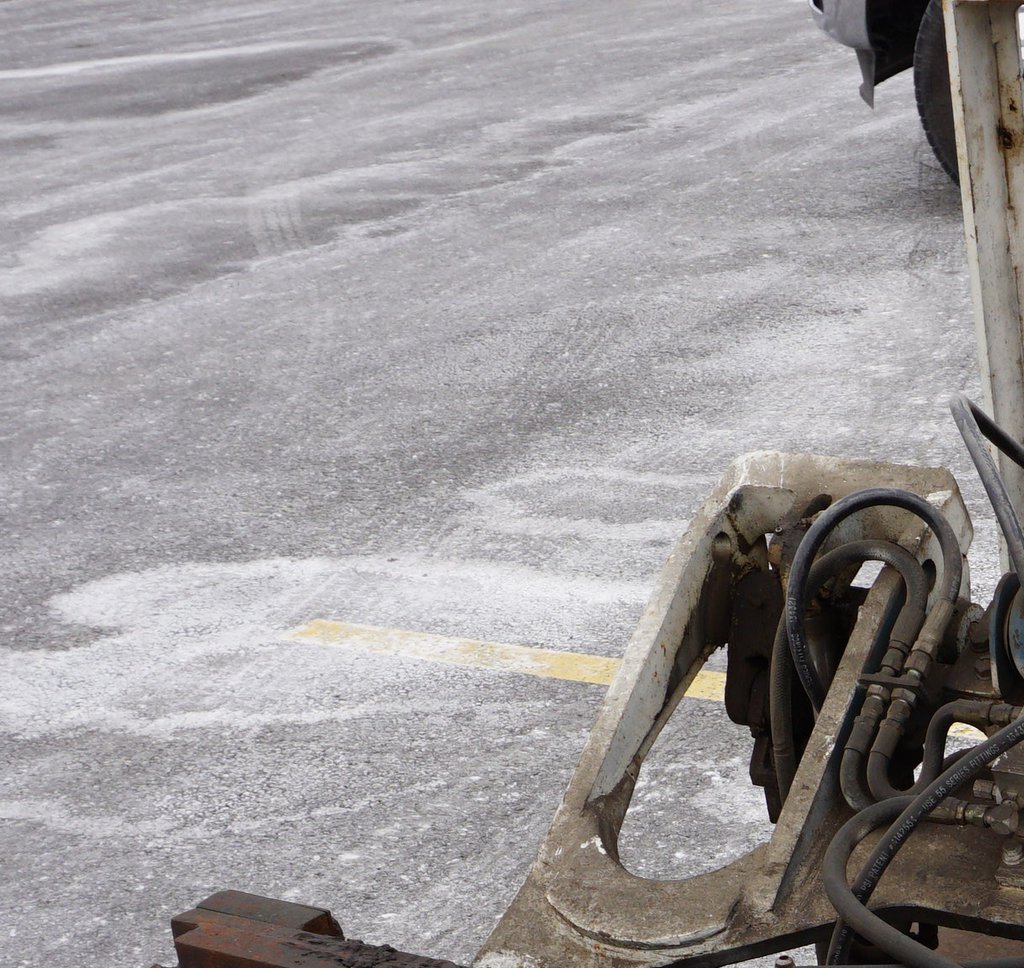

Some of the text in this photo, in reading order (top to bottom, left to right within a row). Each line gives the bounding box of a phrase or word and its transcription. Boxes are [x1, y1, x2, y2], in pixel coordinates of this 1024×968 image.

[921, 797, 935, 810] USE
[935, 786, 947, 798] 55
[946, 766, 971, 788] SERIES
[969, 743, 1001, 769] FITTINGS
